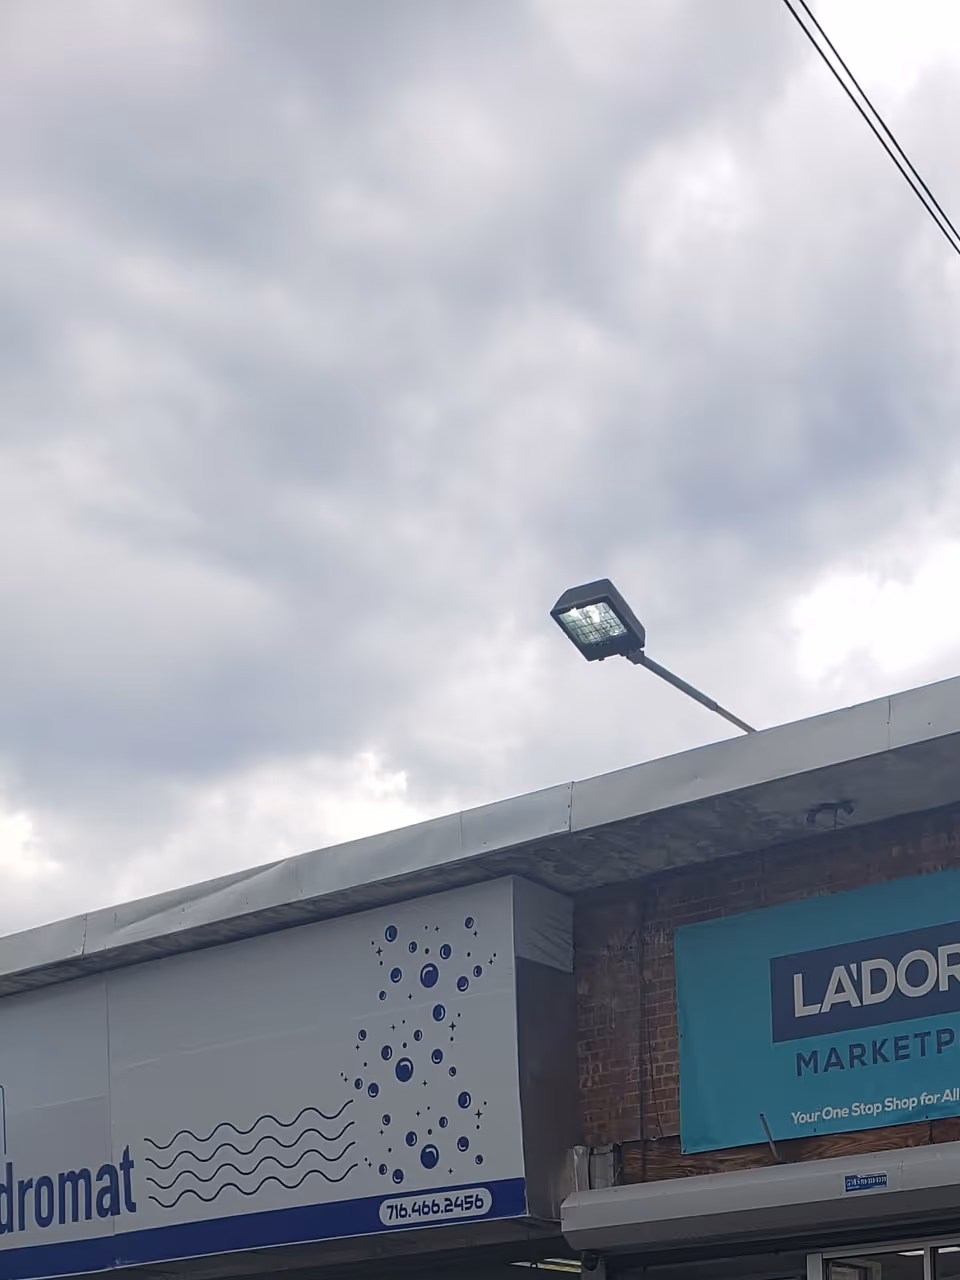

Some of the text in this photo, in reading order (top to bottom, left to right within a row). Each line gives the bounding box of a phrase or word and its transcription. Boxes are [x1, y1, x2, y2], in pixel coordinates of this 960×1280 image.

[791, 1111, 821, 1124] Your
[822, 1106, 849, 1120] One
[851, 1102, 882, 1117] Stop
[884, 1097, 918, 1112] Shop
[919, 1093, 941, 1105] for
[941, 1088, 960, 1102] All
[387, 1194, 484, 1220] 716.466.2456
